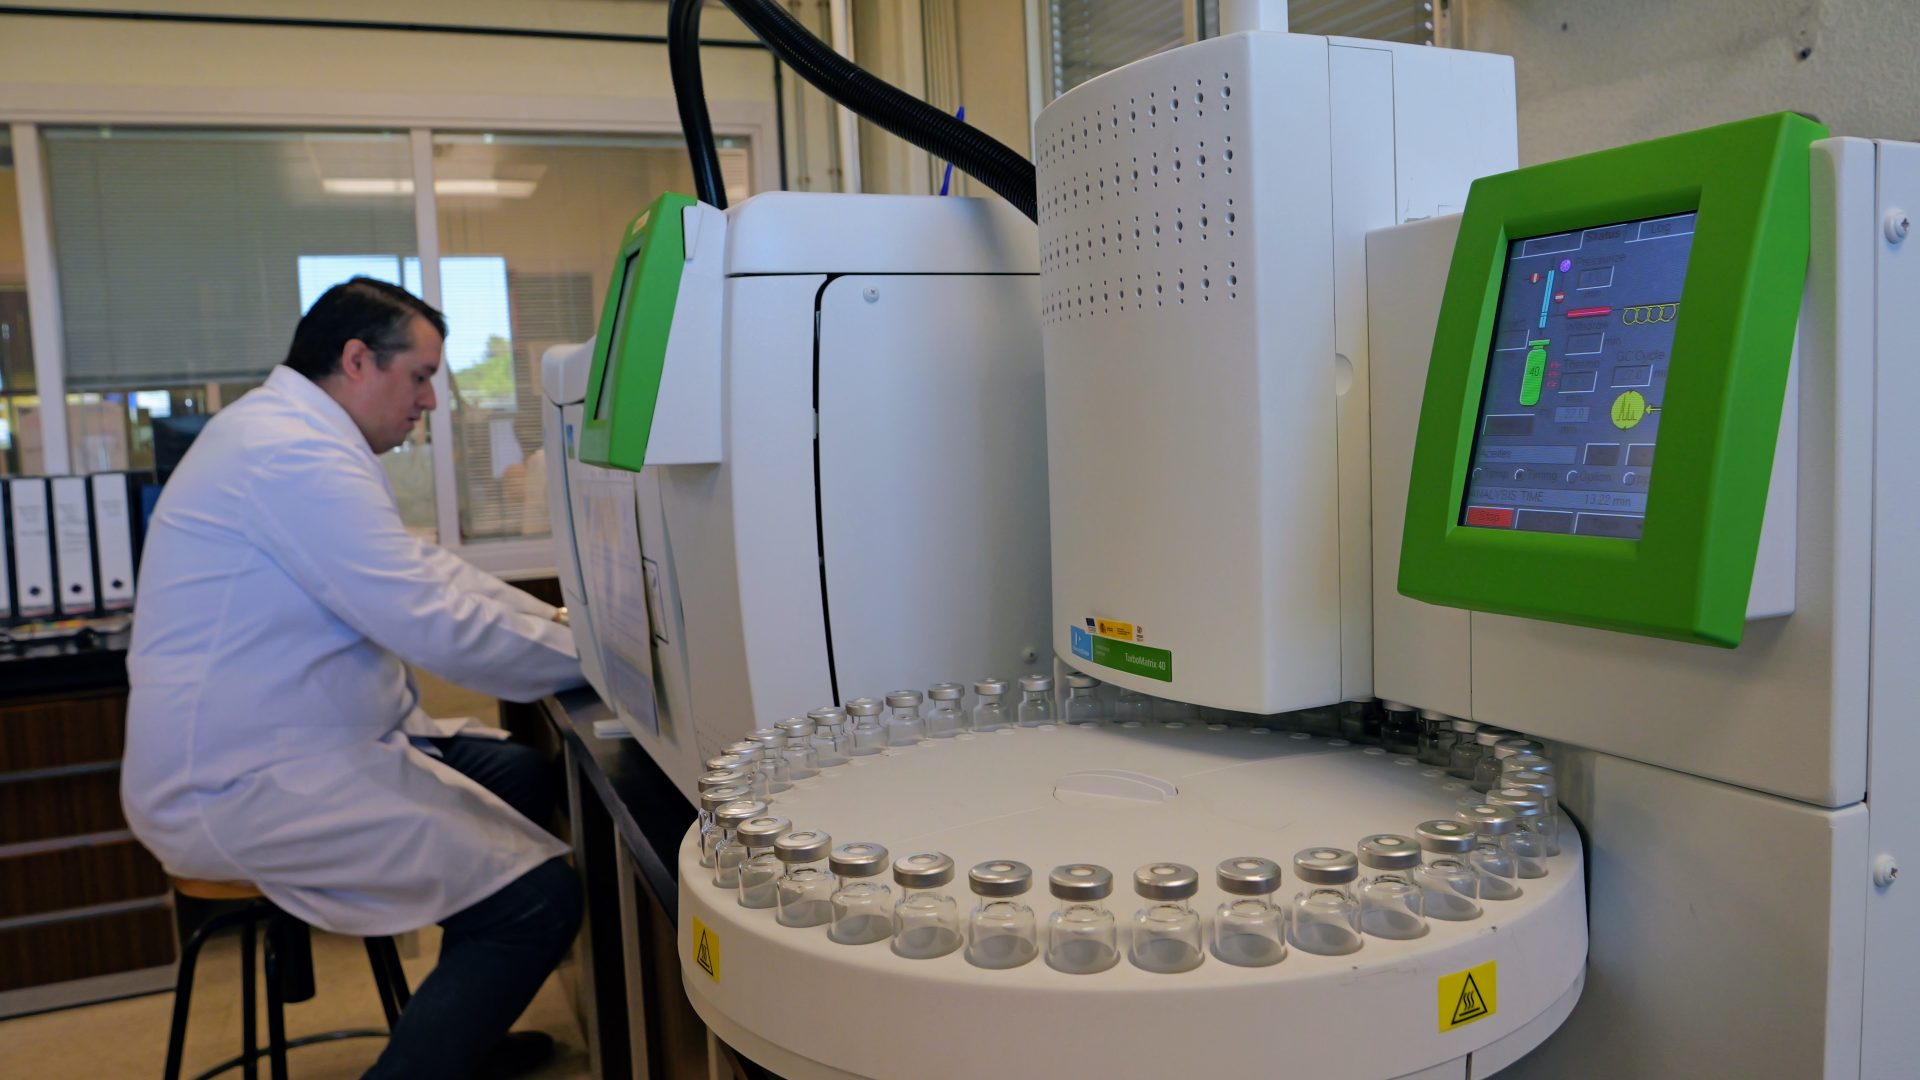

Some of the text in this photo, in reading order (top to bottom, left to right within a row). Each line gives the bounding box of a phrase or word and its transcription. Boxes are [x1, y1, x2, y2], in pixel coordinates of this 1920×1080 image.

[1651, 223, 1672, 234] Log
[1585, 230, 1621, 241] Status
[1616, 349, 1666, 363] GC Cycle
[1529, 366, 1540, 376] 40
[1527, 469, 1558, 483] Timing
[1521, 491, 1545, 502] TIME
[1585, 494, 1611, 506] 13.22
[1613, 498, 1632, 506] min
[1479, 511, 1500, 522] Stop
[1125, 652, 1166, 671] TurboMatrix 40
